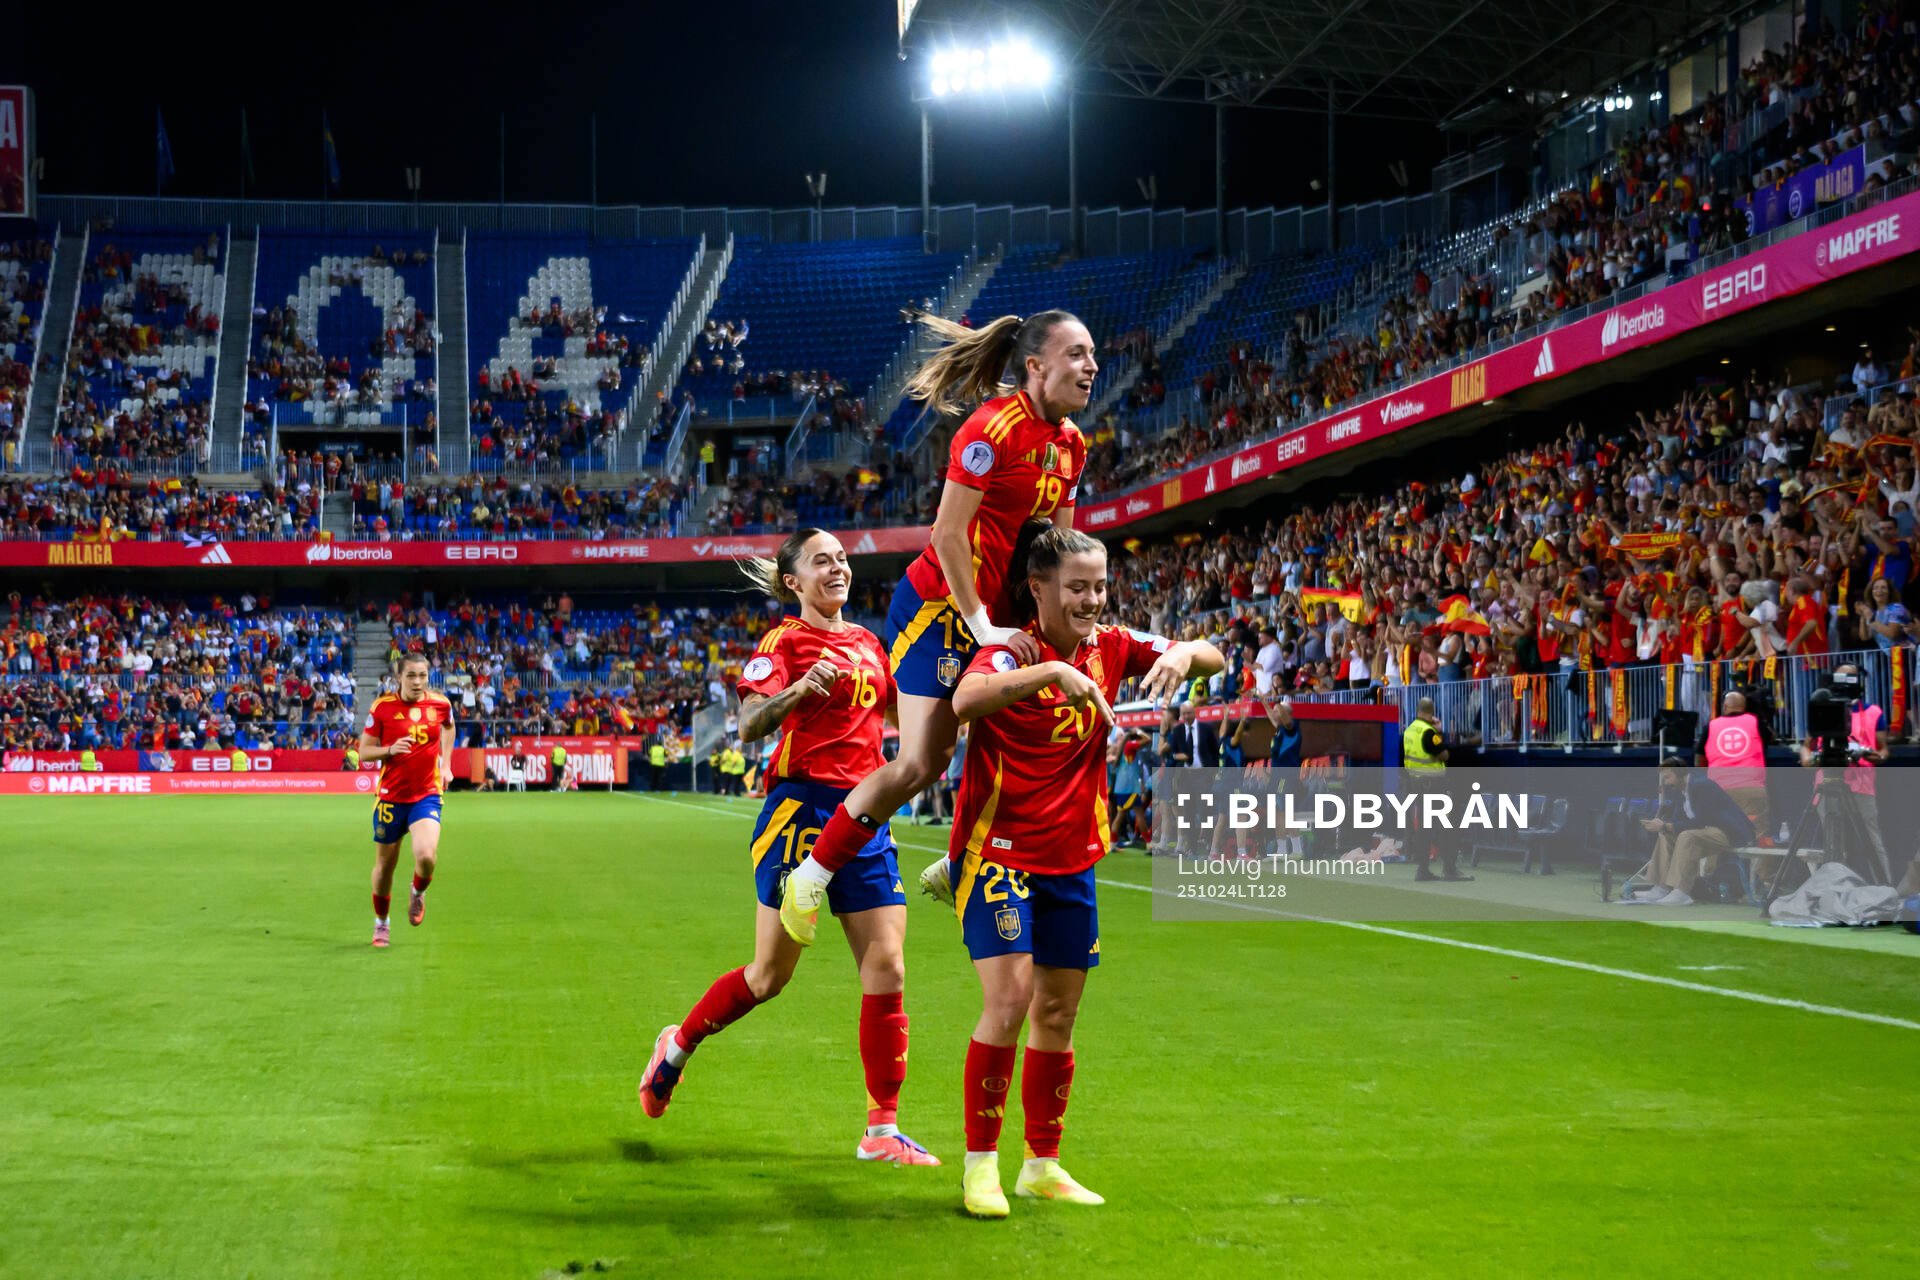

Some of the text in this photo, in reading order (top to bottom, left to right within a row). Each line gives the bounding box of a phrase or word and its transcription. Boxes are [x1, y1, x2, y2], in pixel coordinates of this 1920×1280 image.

[1829, 214, 1900, 263] MAPFRE
[1619, 303, 1665, 341] Iberdrola
[1331, 416, 1361, 442] MAPFRE
[1030, 473, 1062, 516] 19
[48, 543, 113, 565] MÁLAGA
[333, 547, 393, 561] Iberdrola
[584, 545, 649, 558] MAPFRE
[850, 669, 877, 708] 16
[1051, 699, 1097, 743] 20
[408, 724, 429, 745] 15
[36, 759, 104, 771] Iberdra
[192, 757, 272, 771] EBO
[486, 754, 546, 781] VAOS
[48, 776, 151, 792] MAPFRE
[170, 779, 180, 788] Tu
[181, 778, 220, 788] referente
[221, 780, 232, 788] en
[378, 803, 393, 823] 15
[781, 824, 822, 864] 16
[979, 861, 1030, 903] 20
